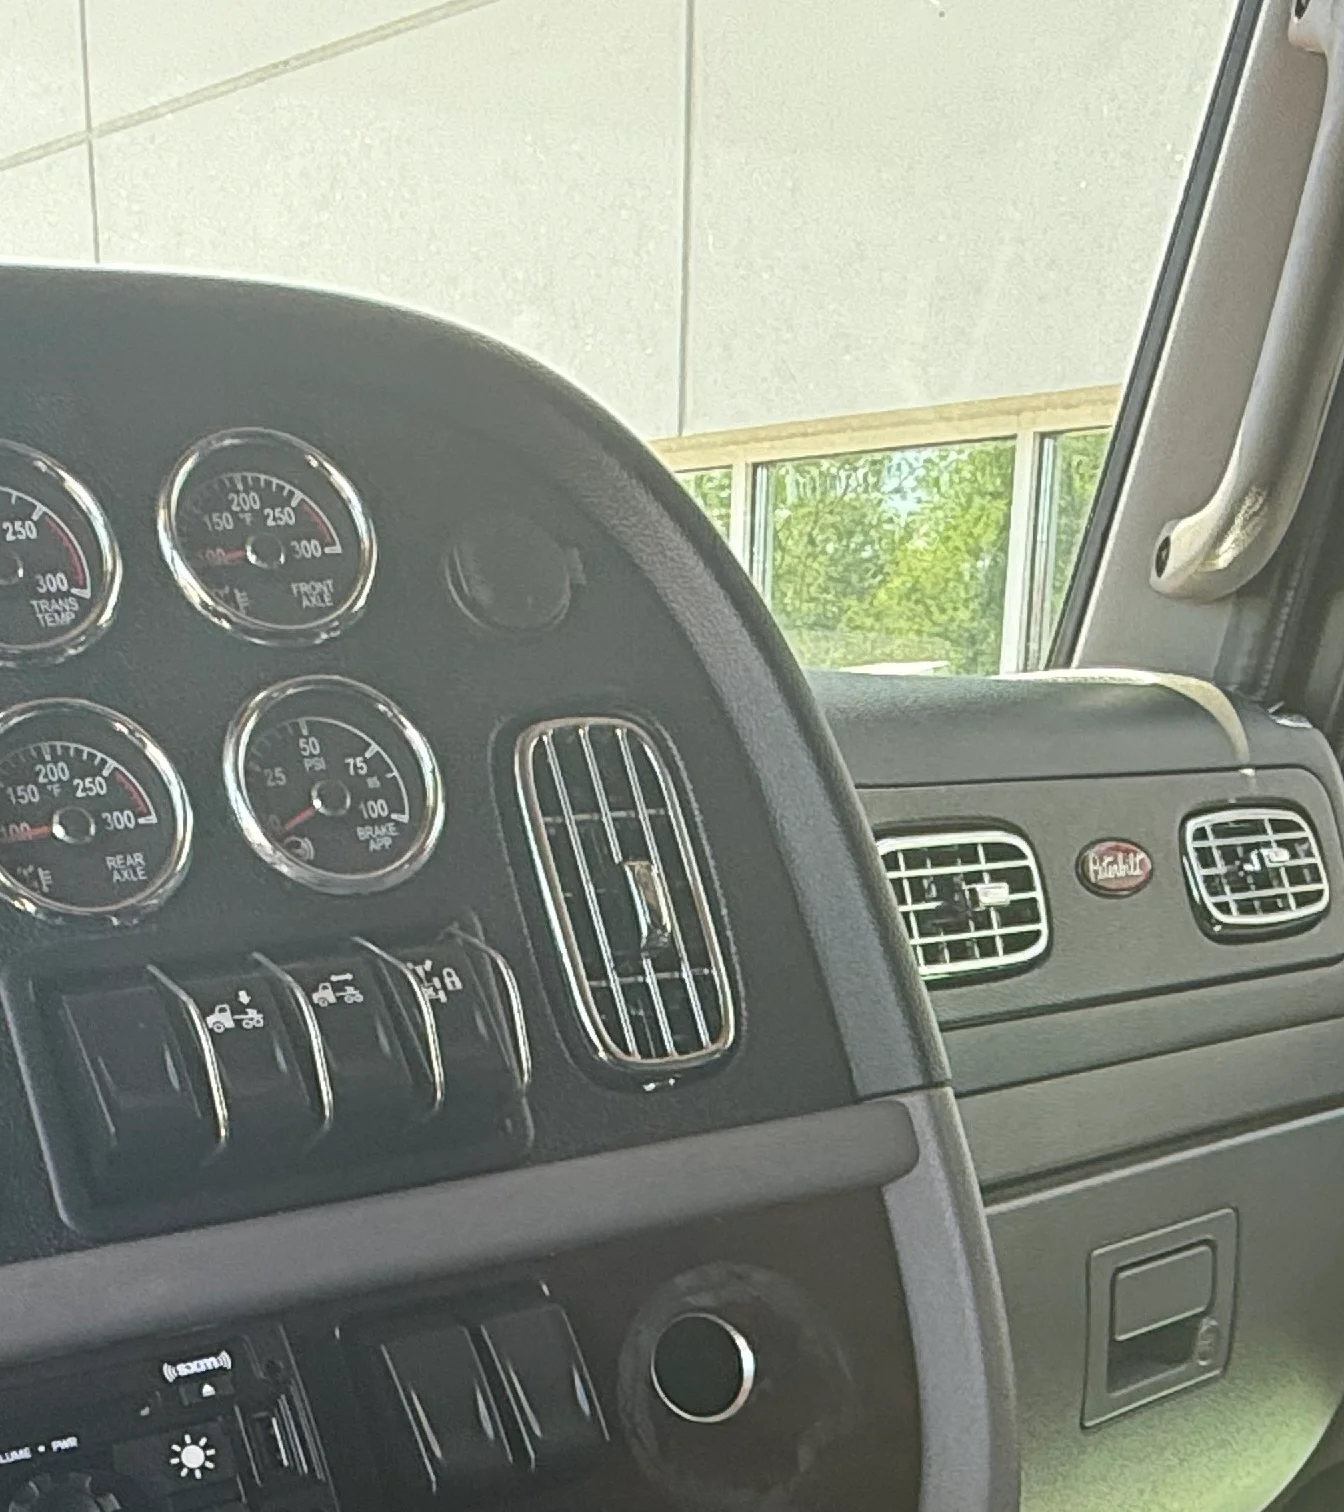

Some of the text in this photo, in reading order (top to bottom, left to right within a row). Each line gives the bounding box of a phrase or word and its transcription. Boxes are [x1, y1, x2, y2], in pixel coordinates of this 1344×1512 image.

[228, 492, 260, 511] 200
[206, 512, 234, 532] 150
[263, 506, 296, 526] 250
[3, 520, 38, 542] 250
[290, 539, 322, 559] 300
[35, 572, 69, 593] 300
[291, 579, 335, 597] FRONT
[30, 596, 80, 614] TRANS
[302, 594, 335, 609] AXLE
[36, 611, 76, 628] TEMP
[298, 736, 320, 756] 50
[34, 761, 70, 784] 200
[303, 757, 326, 772] PSI
[344, 756, 368, 776] 75
[72, 776, 107, 798] 250
[264, 767, 286, 787] 25
[6, 784, 40, 806] 150
[358, 798, 389, 820] 100
[101, 809, 135, 831] 300
[356, 823, 400, 841] BRAKE
[368, 837, 392, 852] APP
[106, 852, 145, 870] REAR
[112, 867, 148, 884] AXLE
[51, 1436, 78, 1452] PWR
